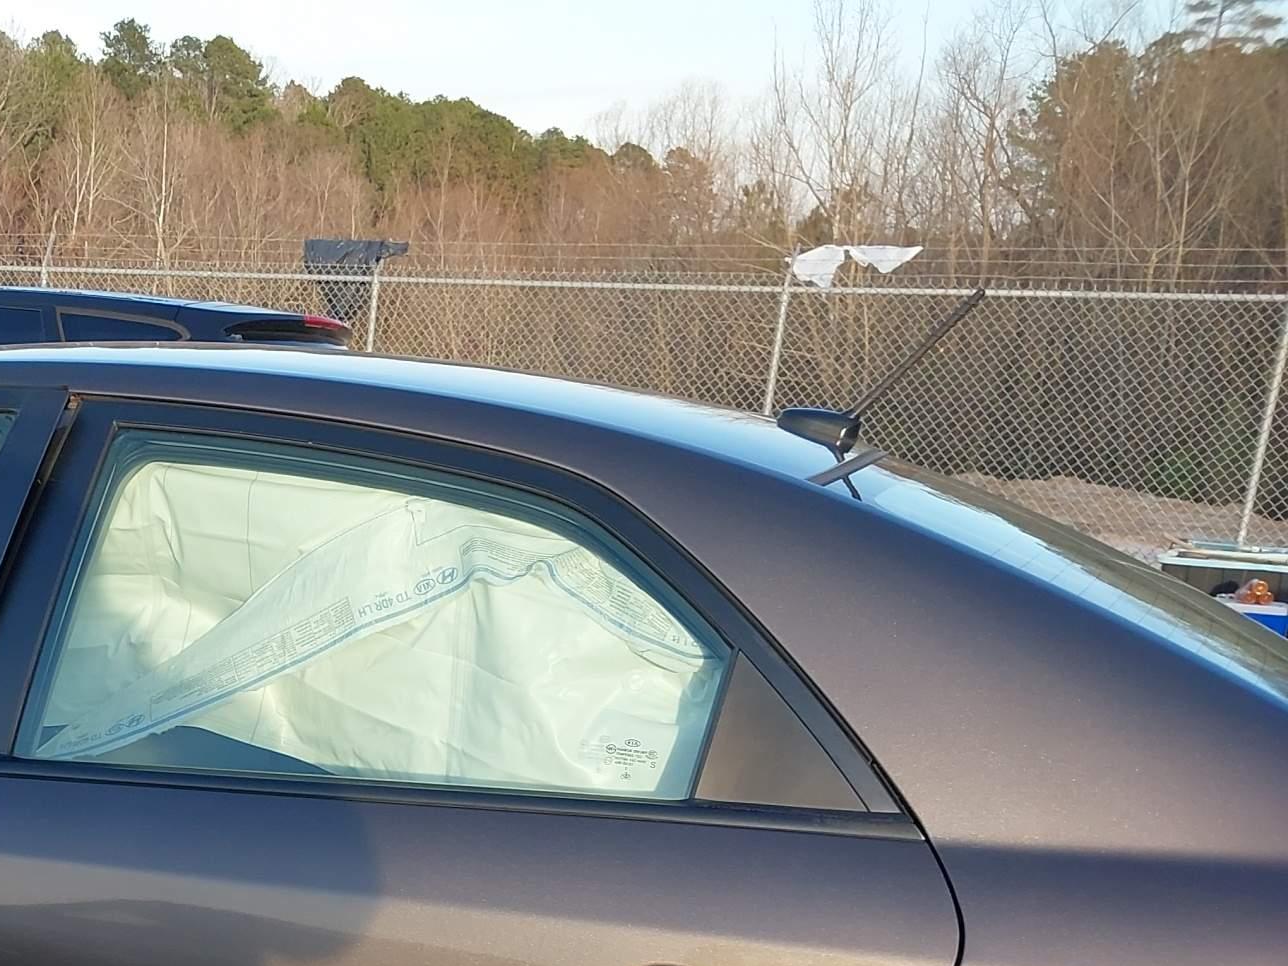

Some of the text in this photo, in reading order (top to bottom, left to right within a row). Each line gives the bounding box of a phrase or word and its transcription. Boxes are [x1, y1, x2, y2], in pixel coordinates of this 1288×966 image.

[415, 580, 434, 595] KIA
[395, 591, 412, 603] TD
[358, 605, 373, 618] LH
